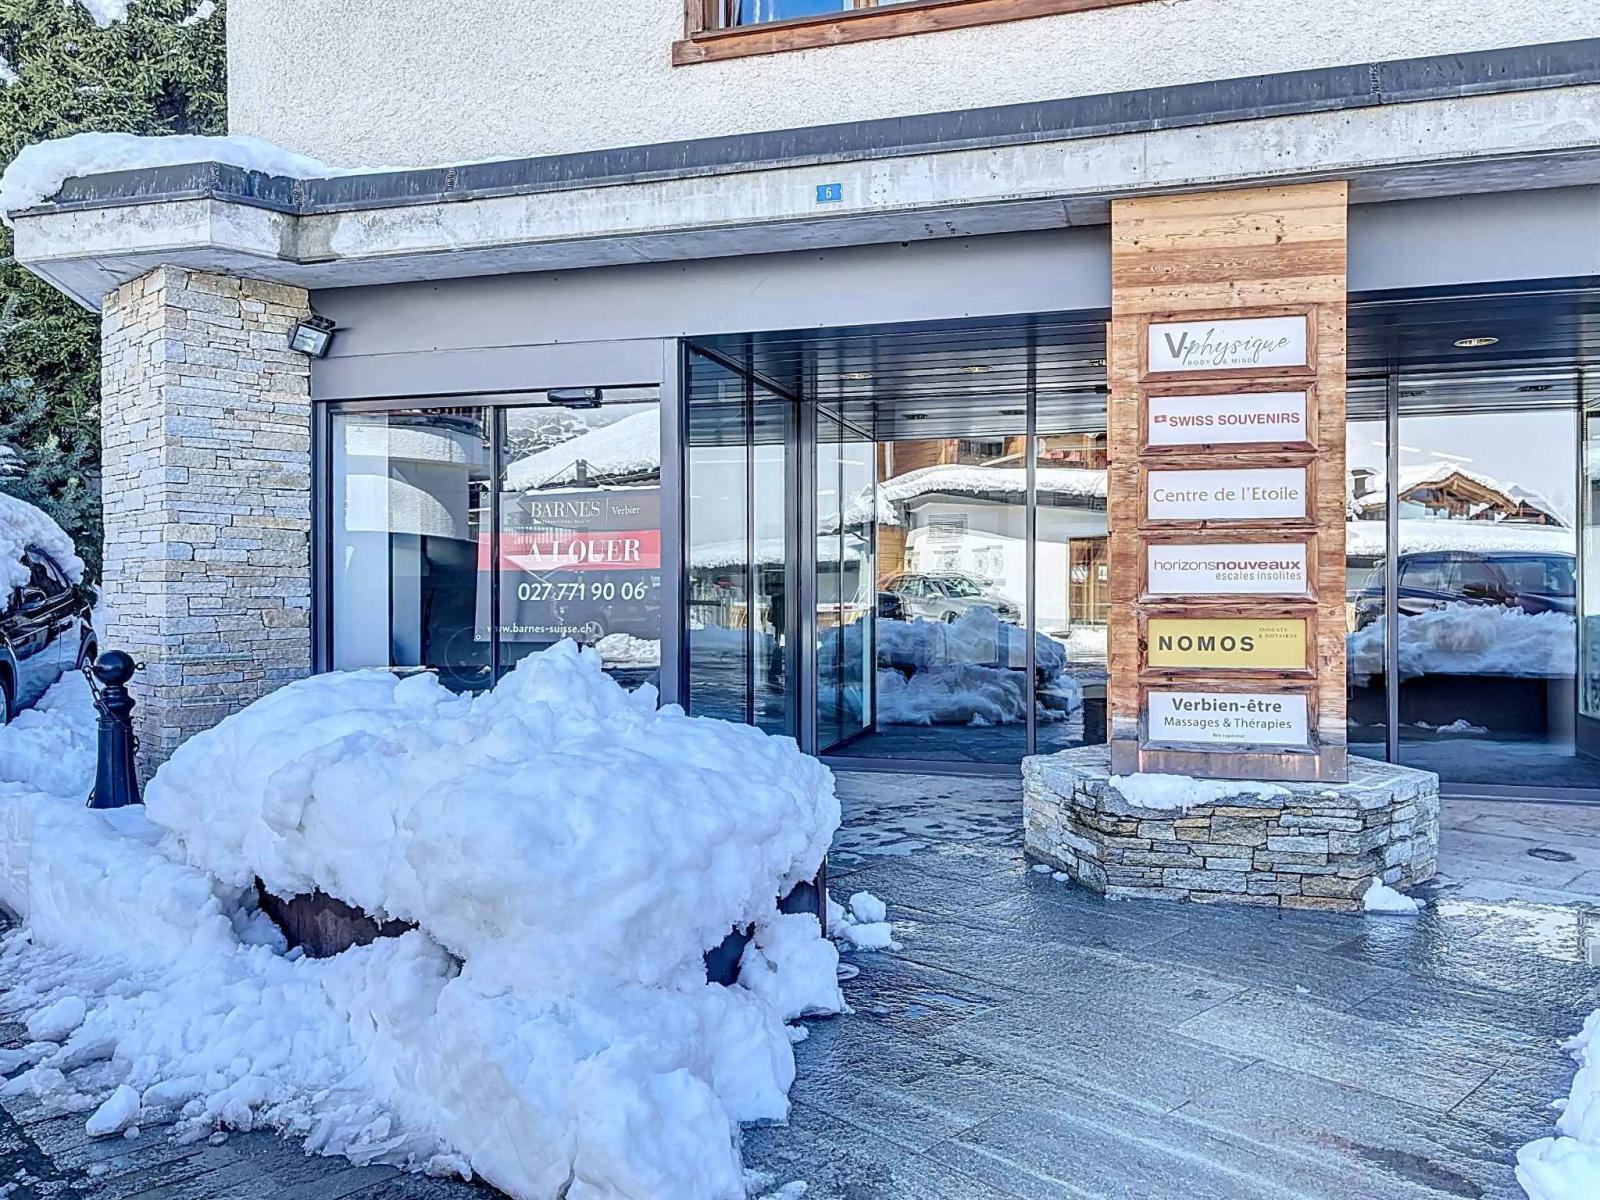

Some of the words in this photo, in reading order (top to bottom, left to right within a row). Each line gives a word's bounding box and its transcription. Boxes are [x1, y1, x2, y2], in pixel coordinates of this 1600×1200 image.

[825, 187, 832, 199] 6
[1169, 415, 1214, 427] SWISS
[1218, 412, 1300, 426] SOUVENIRS
[1153, 488, 1209, 502] Centre
[1214, 487, 1235, 501] de
[1241, 486, 1299, 501] l'Etoile
[531, 501, 600, 517] BARNES
[611, 505, 641, 515] Verbier
[552, 538, 641, 563] LOUER
[1216, 571, 1255, 581] escales
[1257, 571, 1302, 581] insolites
[518, 582, 552, 601] 027
[557, 582, 585, 601] 771
[591, 582, 615, 601] 90
[621, 581, 645, 601] 06
[487, 622, 592, 634] ww.barnes-suisse.ch
[1159, 635, 1255, 652] NOMOS
[1172, 697, 1282, 712] Verbien-être
[1164, 717, 1220, 730] Massages
[1223, 717, 1232, 727] &
[1235, 717, 1292, 731] Thérapies
